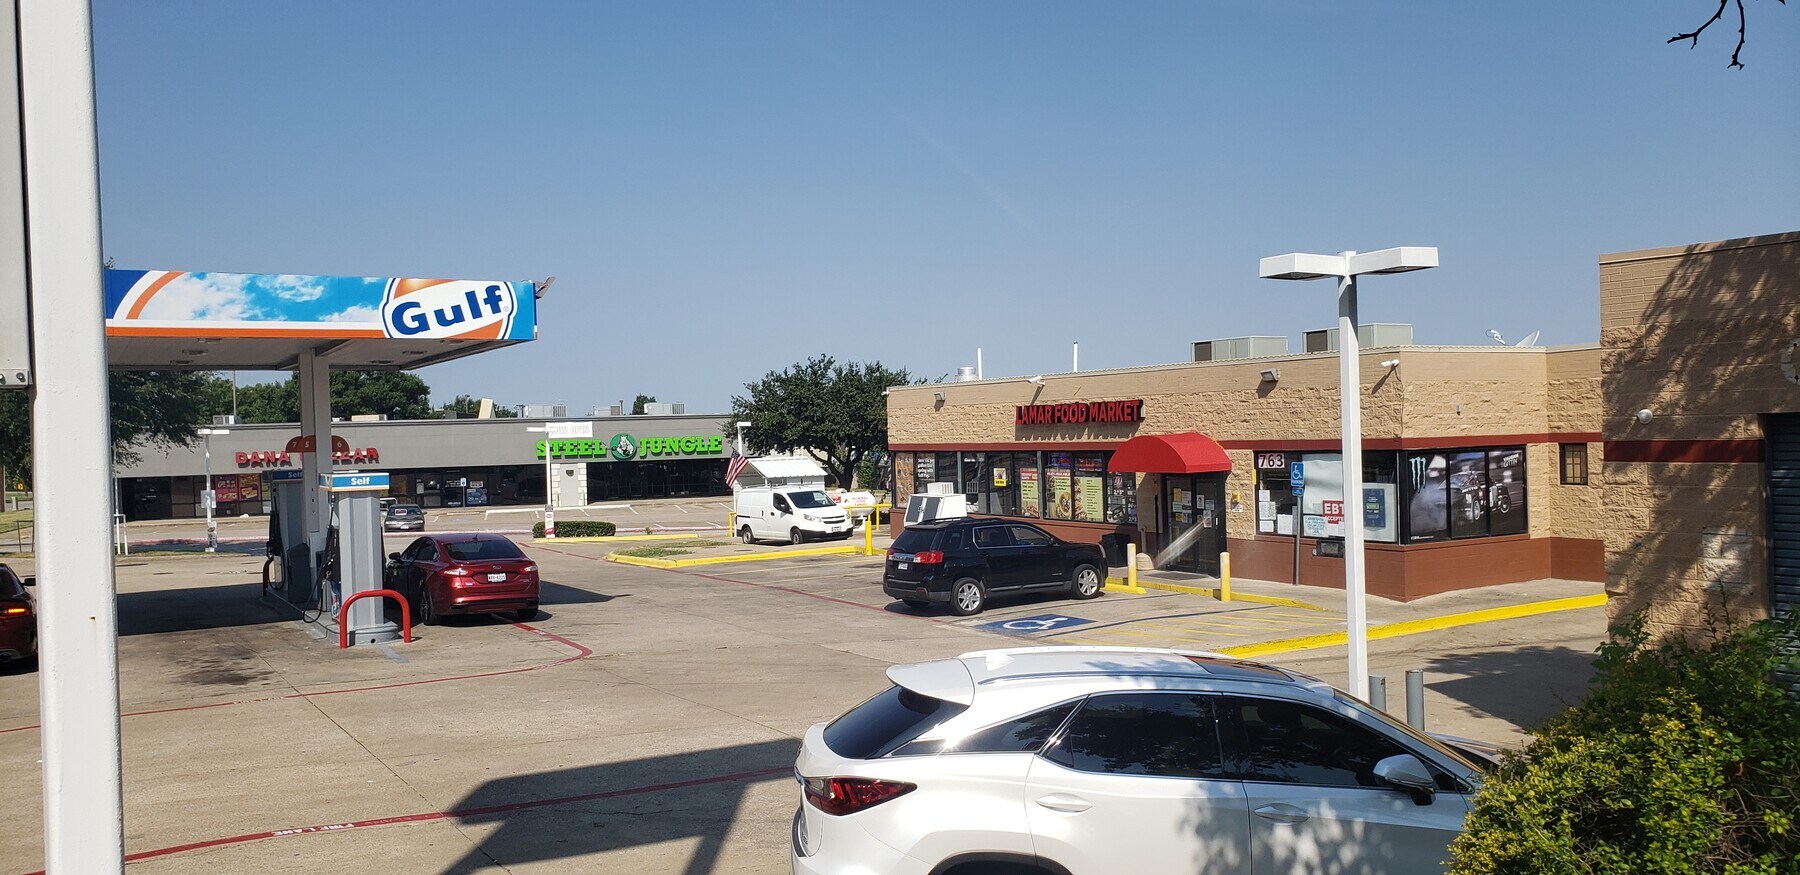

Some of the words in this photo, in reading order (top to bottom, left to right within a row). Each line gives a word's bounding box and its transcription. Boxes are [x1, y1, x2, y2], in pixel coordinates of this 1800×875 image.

[391, 285, 503, 335] Gulf
[1016, 405, 1052, 425] LAMAR
[1055, 403, 1086, 423] FOOD
[1089, 400, 1140, 422] MARKET
[570, 425, 590, 434] OPEN
[536, 439, 607, 459] STEEL
[639, 435, 722, 458] JUNGLE
[235, 451, 290, 464] DANA
[1259, 454, 1284, 468] 763
[350, 476, 371, 486] Self
